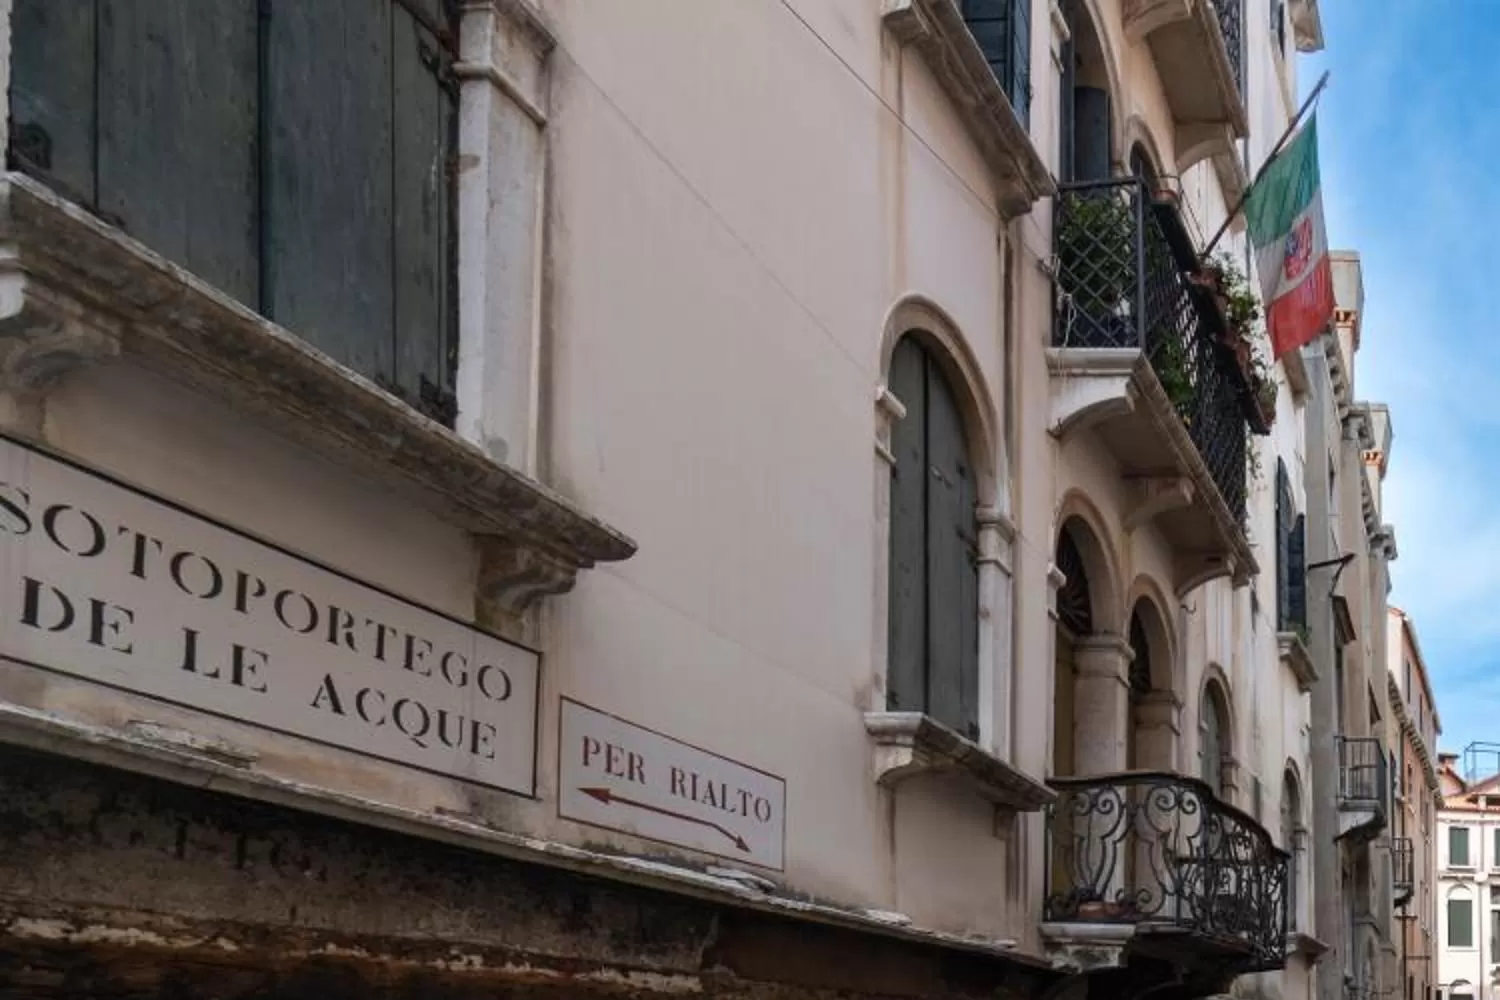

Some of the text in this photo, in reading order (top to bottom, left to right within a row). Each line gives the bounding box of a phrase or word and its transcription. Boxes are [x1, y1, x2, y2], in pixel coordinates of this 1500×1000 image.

[0, 482, 513, 702] SOTOPORTEGO
[18, 576, 498, 761] DE LE ACQUE
[581, 735, 772, 824] PER RIALTO
